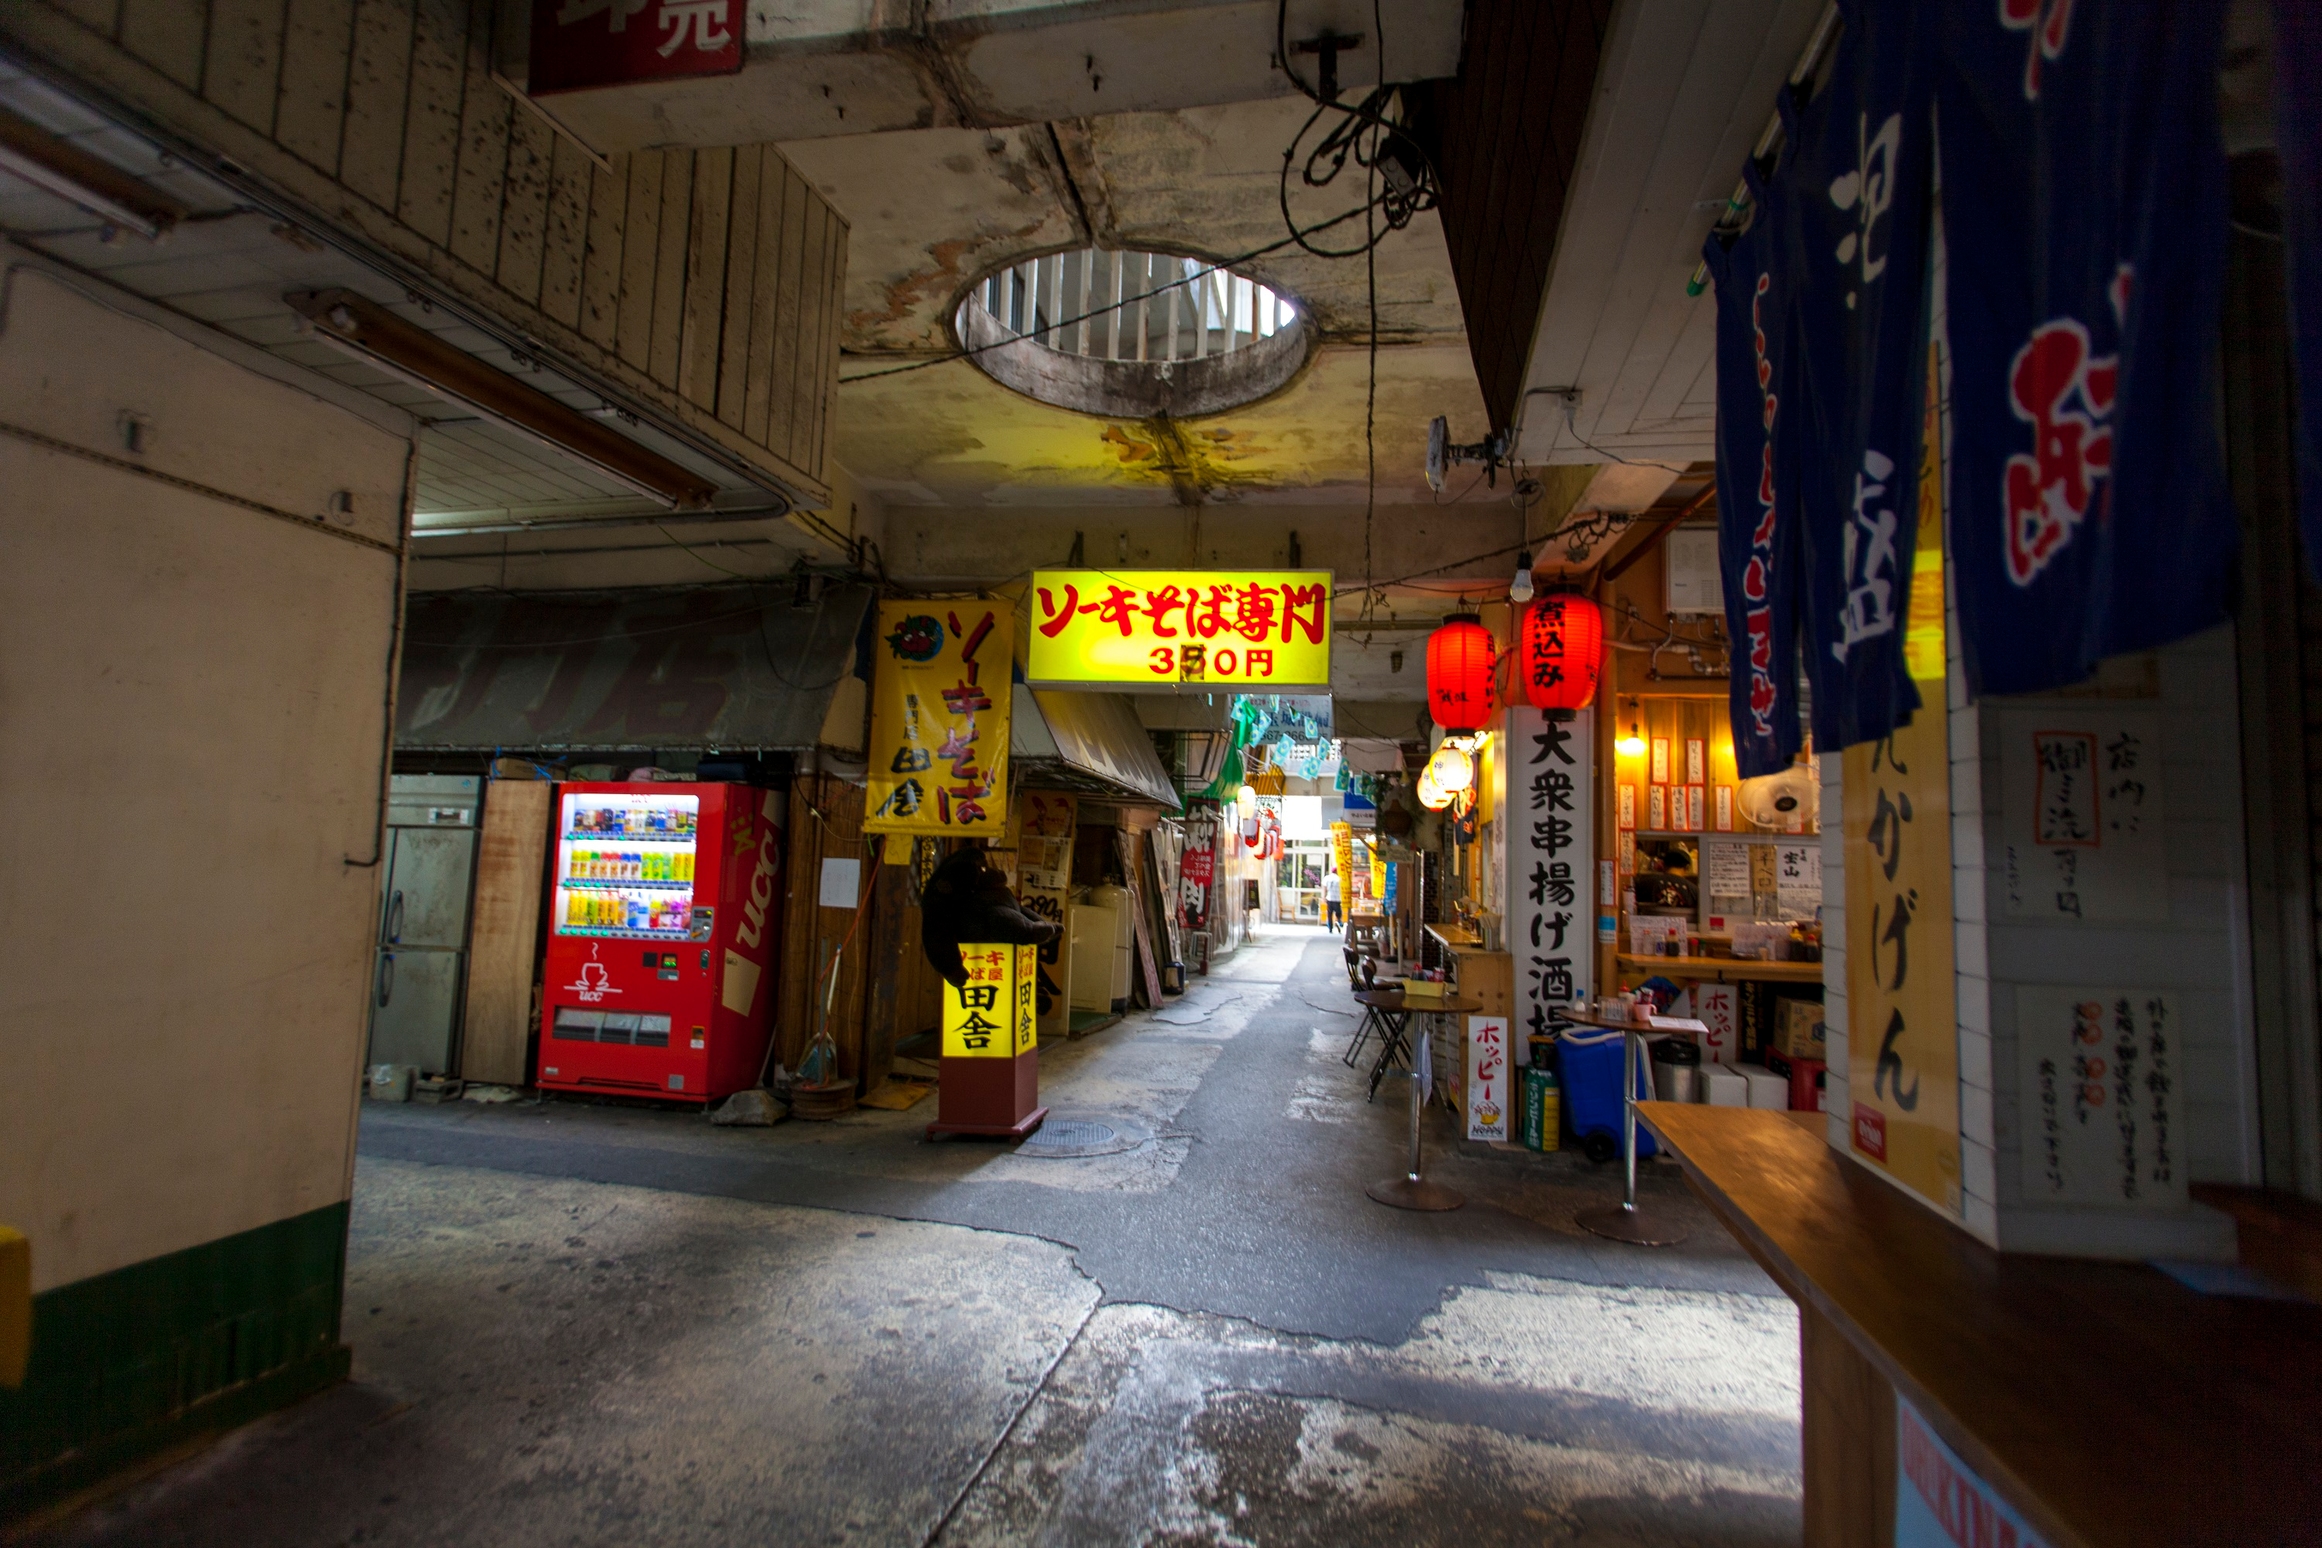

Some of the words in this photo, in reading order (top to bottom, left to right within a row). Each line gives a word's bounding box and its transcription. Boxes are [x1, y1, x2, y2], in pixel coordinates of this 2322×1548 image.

[1036, 582, 1326, 645] ソーキそば専門
[1534, 601, 1567, 688] 煮込み
[903, 693, 919, 741] 専門店
[937, 610, 996, 825] ソーキそば
[876, 745, 932, 817] 田舎
[970, 967, 1003, 981] ば屋
[953, 985, 1002, 1049] 田舎
[1018, 980, 1033, 1046] 田舎
[1705, 990, 1732, 1063] ホッピー
[1476, 1020, 1503, 1101] ホッピー
